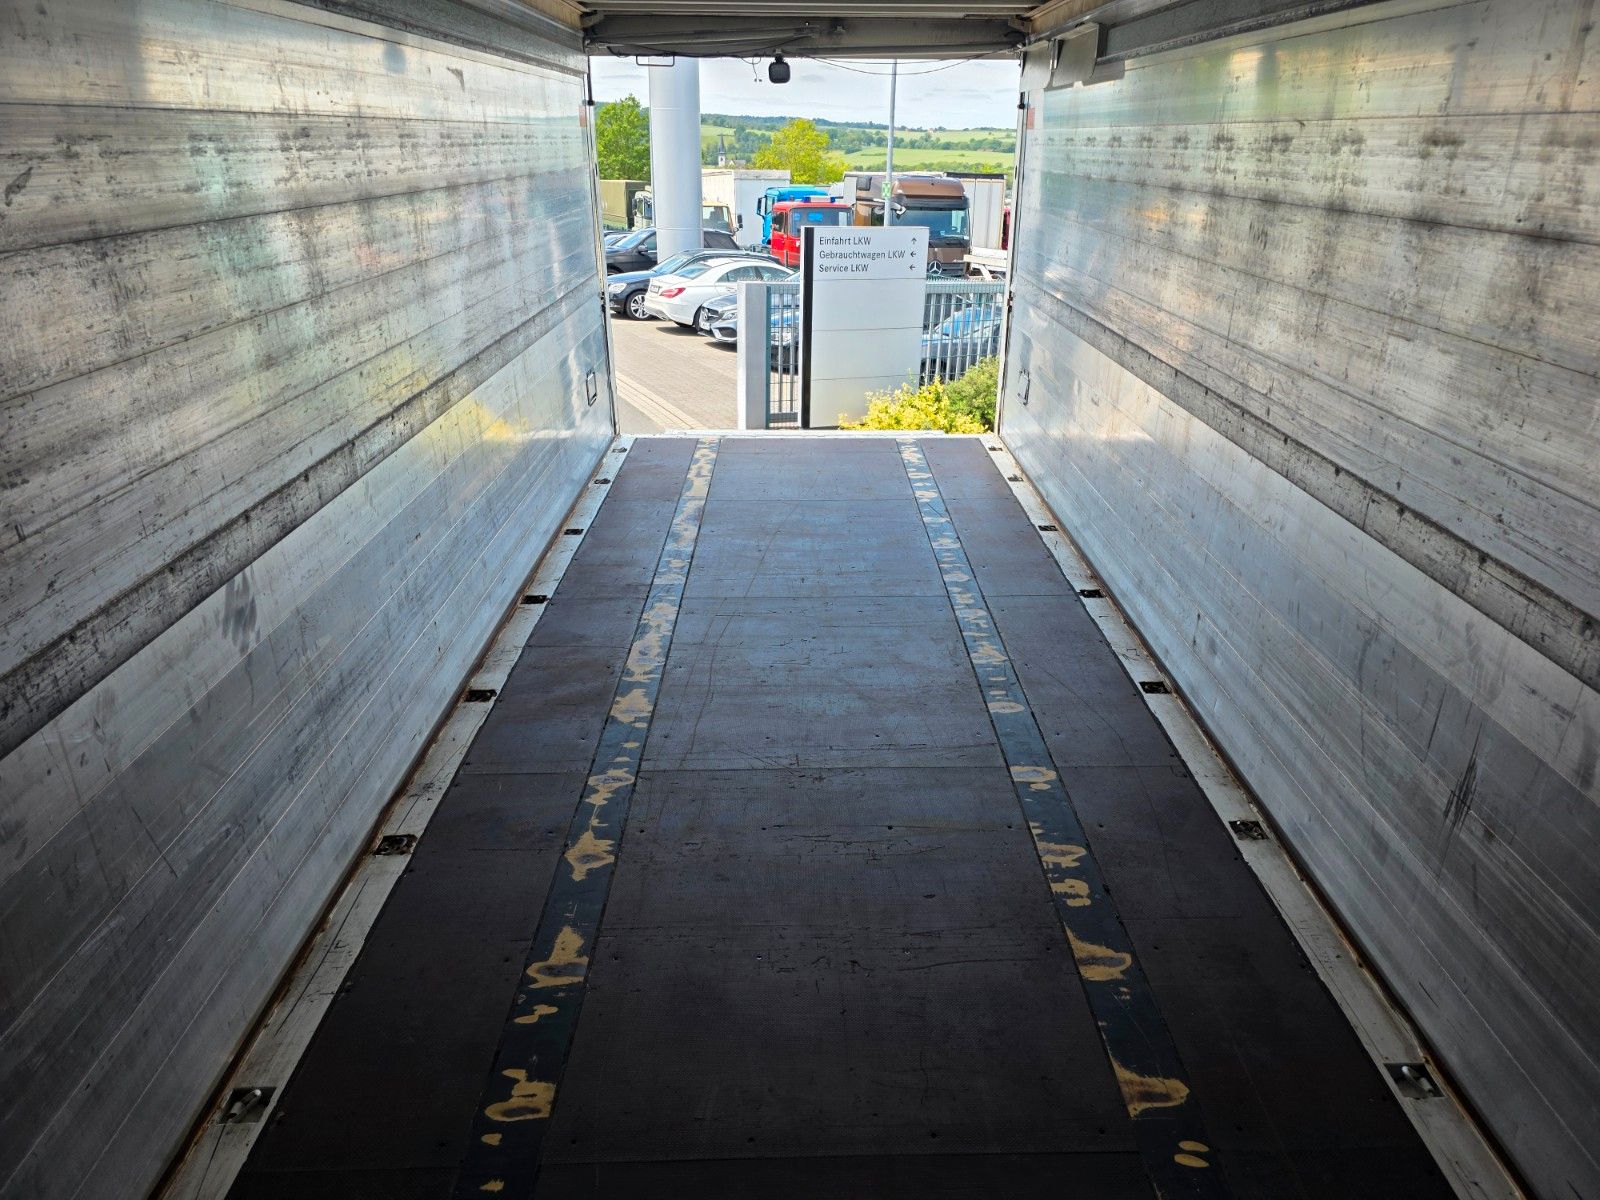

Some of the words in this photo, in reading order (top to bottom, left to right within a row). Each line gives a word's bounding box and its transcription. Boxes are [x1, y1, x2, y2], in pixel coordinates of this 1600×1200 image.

[819, 236, 851, 245] Einfahrt
[853, 236, 872, 245] LKW
[819, 250, 886, 260] Gebrauchtwagen
[887, 250, 906, 259] LKW
[818, 264, 849, 272] Service
[850, 264, 869, 272] LKW
